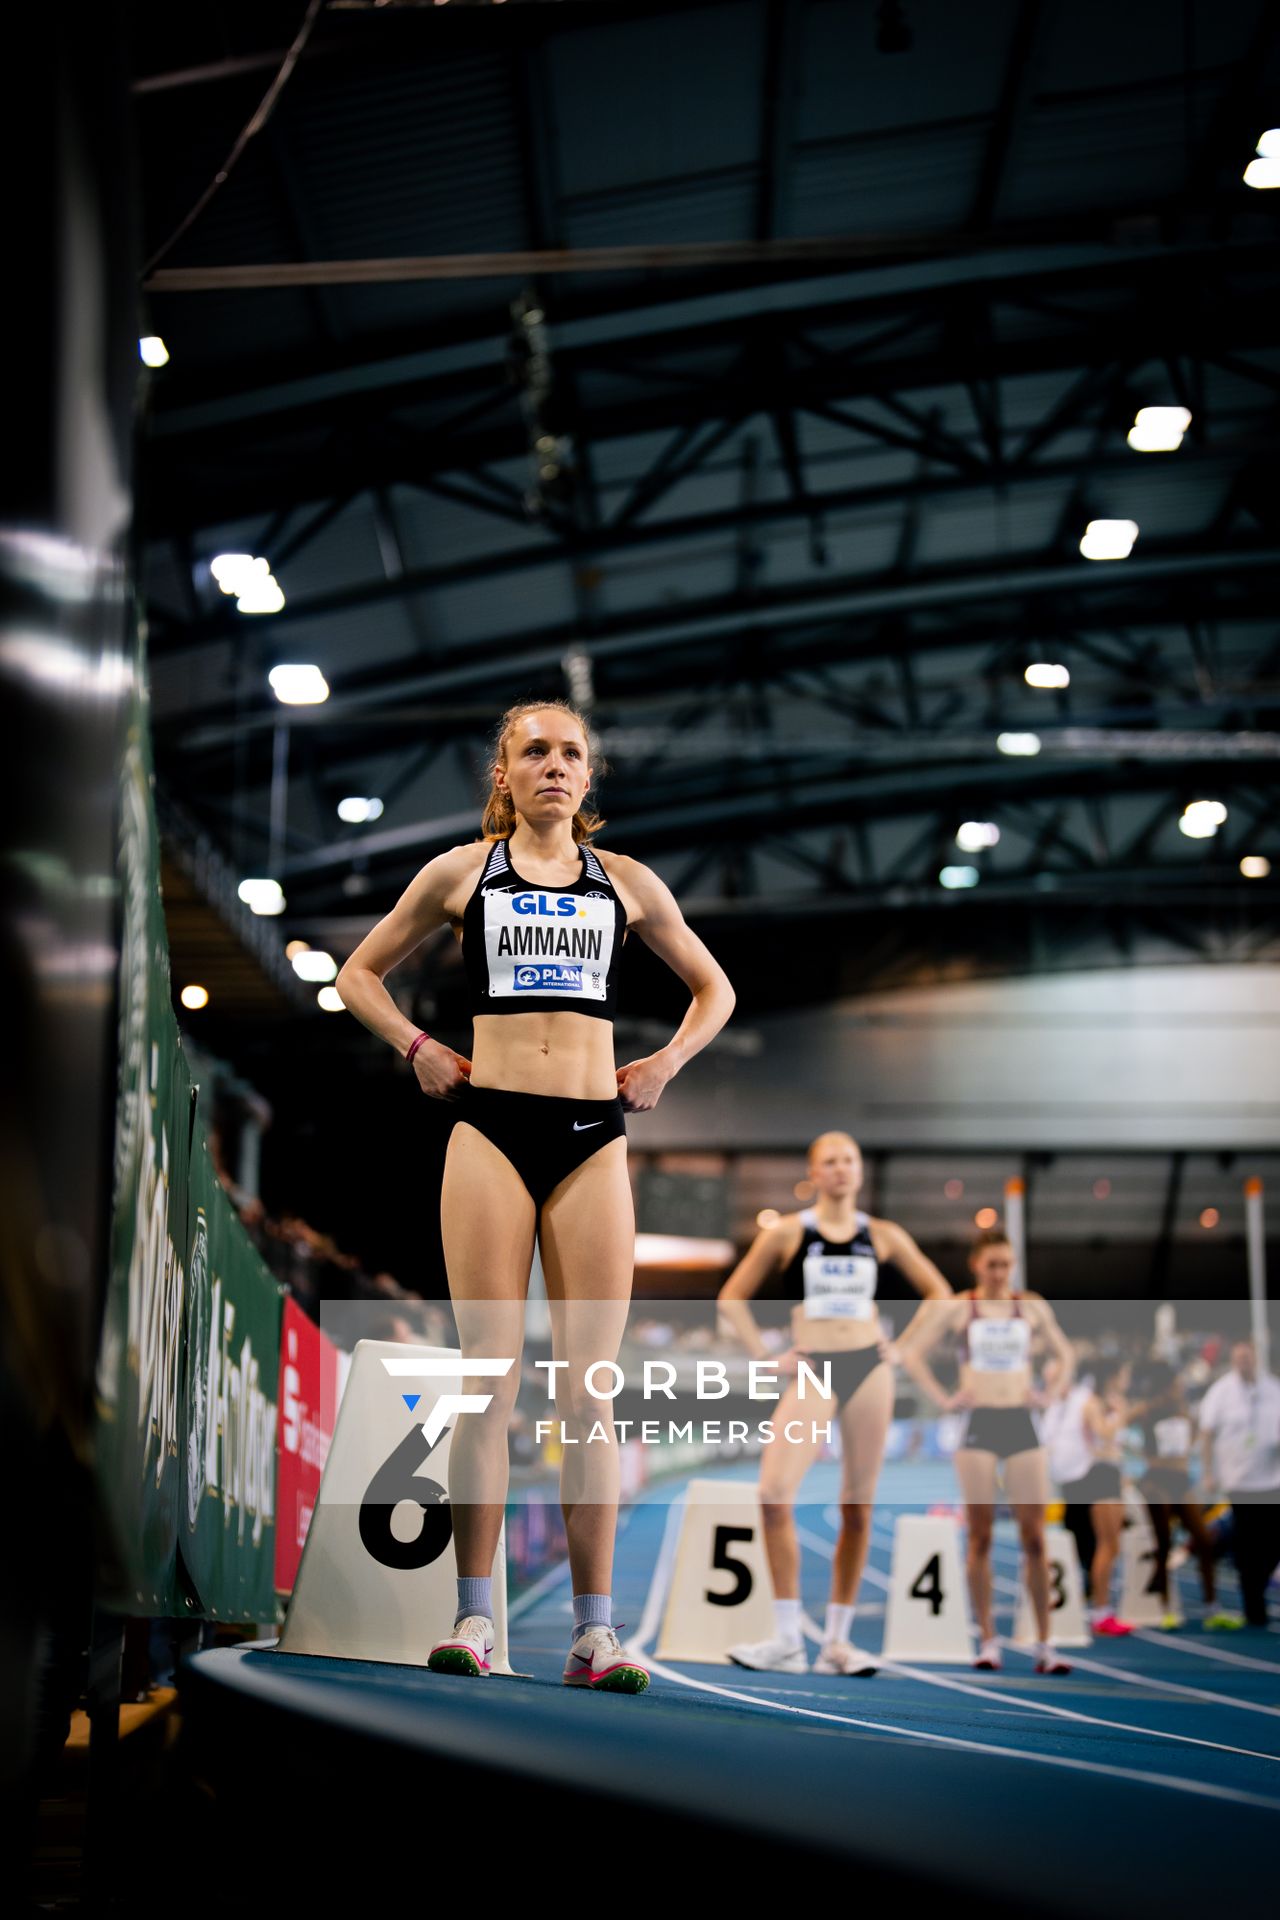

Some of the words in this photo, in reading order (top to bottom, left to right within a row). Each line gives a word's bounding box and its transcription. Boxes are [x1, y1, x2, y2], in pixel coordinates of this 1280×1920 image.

[498, 926, 602, 960] AMMANN
[543, 969, 580, 982] PLAN
[359, 1424, 453, 1570] 6
[706, 1525, 754, 1607] 5
[910, 1552, 944, 1616] 4
